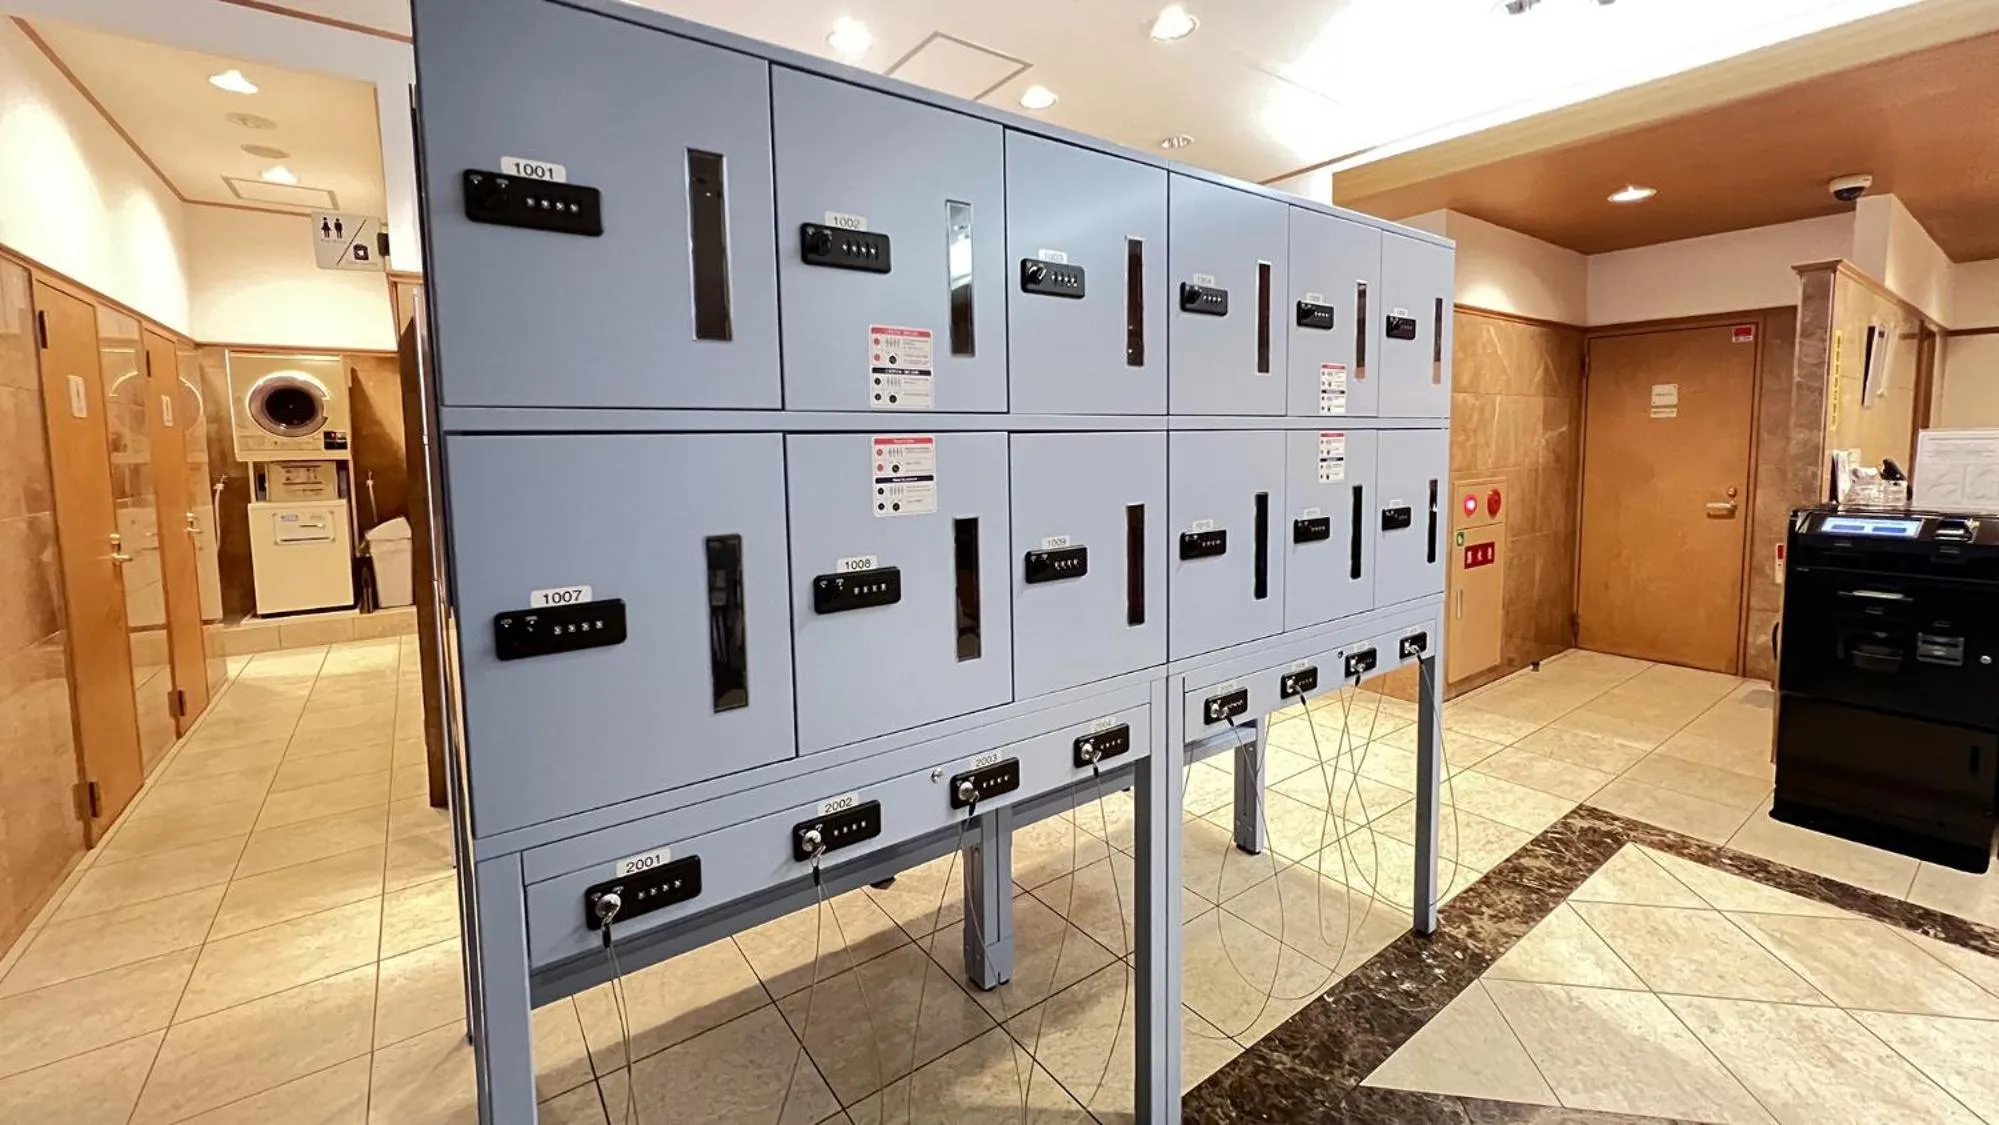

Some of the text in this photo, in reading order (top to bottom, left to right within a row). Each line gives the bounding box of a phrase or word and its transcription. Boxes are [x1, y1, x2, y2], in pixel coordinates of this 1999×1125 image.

[514, 162, 554, 180] 1001
[834, 215, 861, 229] 1002
[845, 559, 871, 570] 1008
[543, 589, 582, 604] 1007
[825, 796, 852, 813] 2002
[626, 854, 660, 873] 2001
